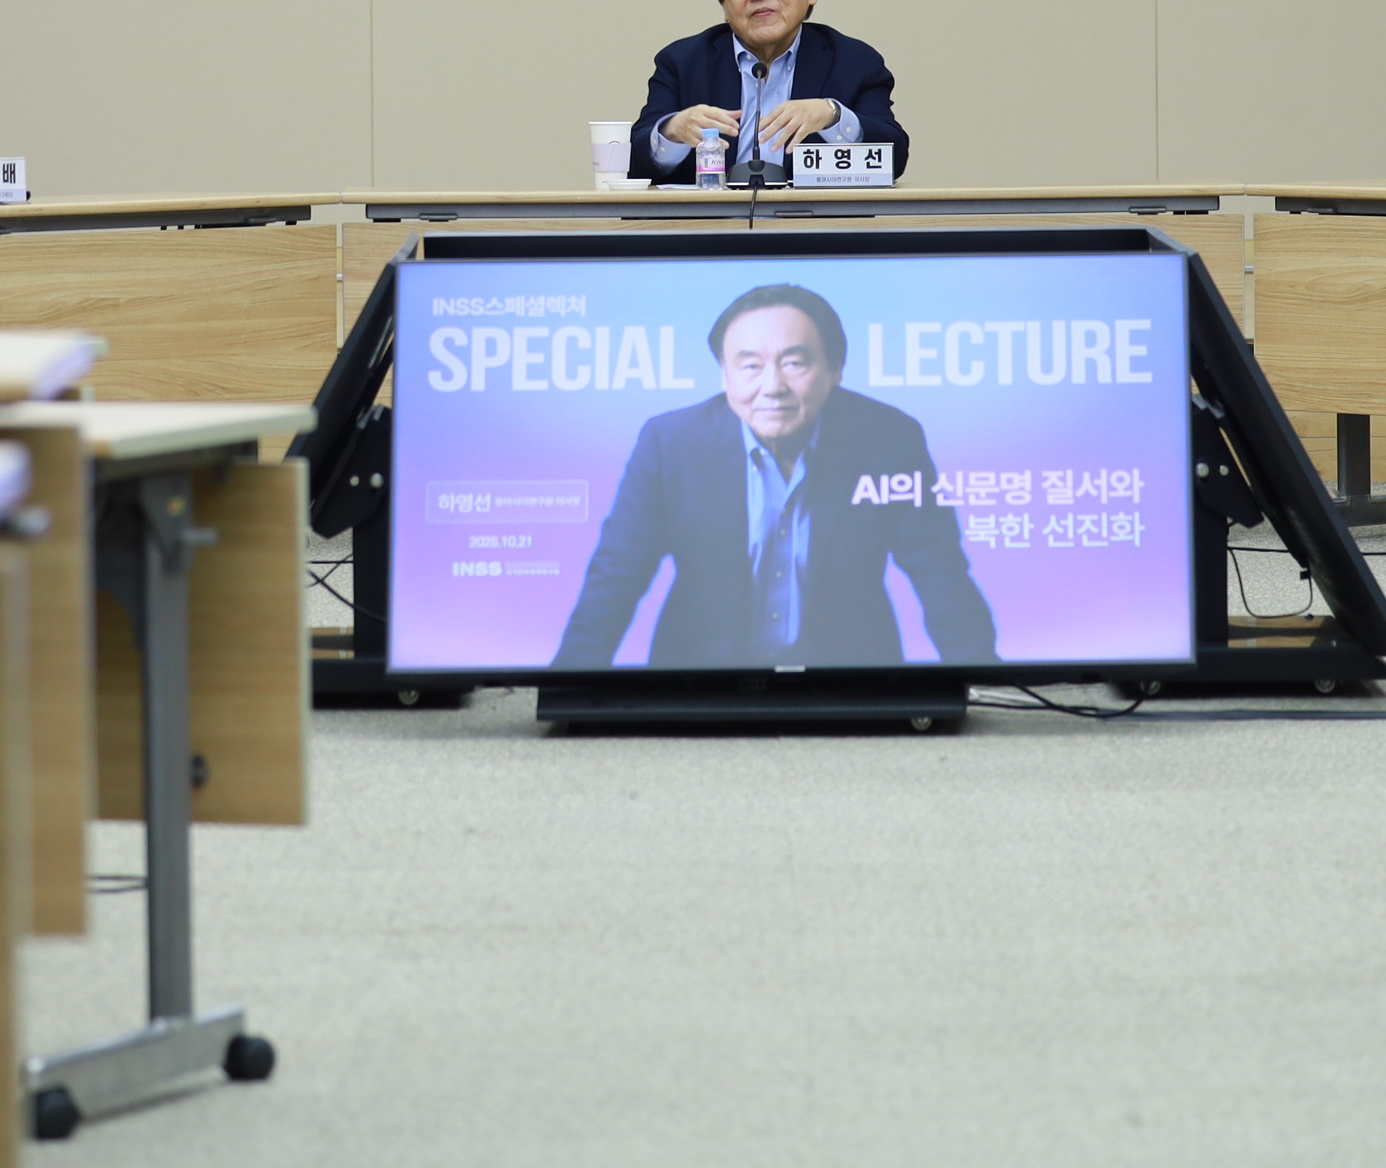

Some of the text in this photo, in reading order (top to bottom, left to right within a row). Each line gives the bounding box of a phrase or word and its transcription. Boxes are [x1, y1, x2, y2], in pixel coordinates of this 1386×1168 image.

[427, 318, 1153, 393] SPECIAL LECTURE
[850, 467, 1145, 508] AI의 신문명 질서와
[438, 493, 492, 513] 하영선
[468, 535, 533, 548] 2025.10.21
[964, 511, 1146, 549] 북한 선진화
[452, 560, 503, 577] INSS
